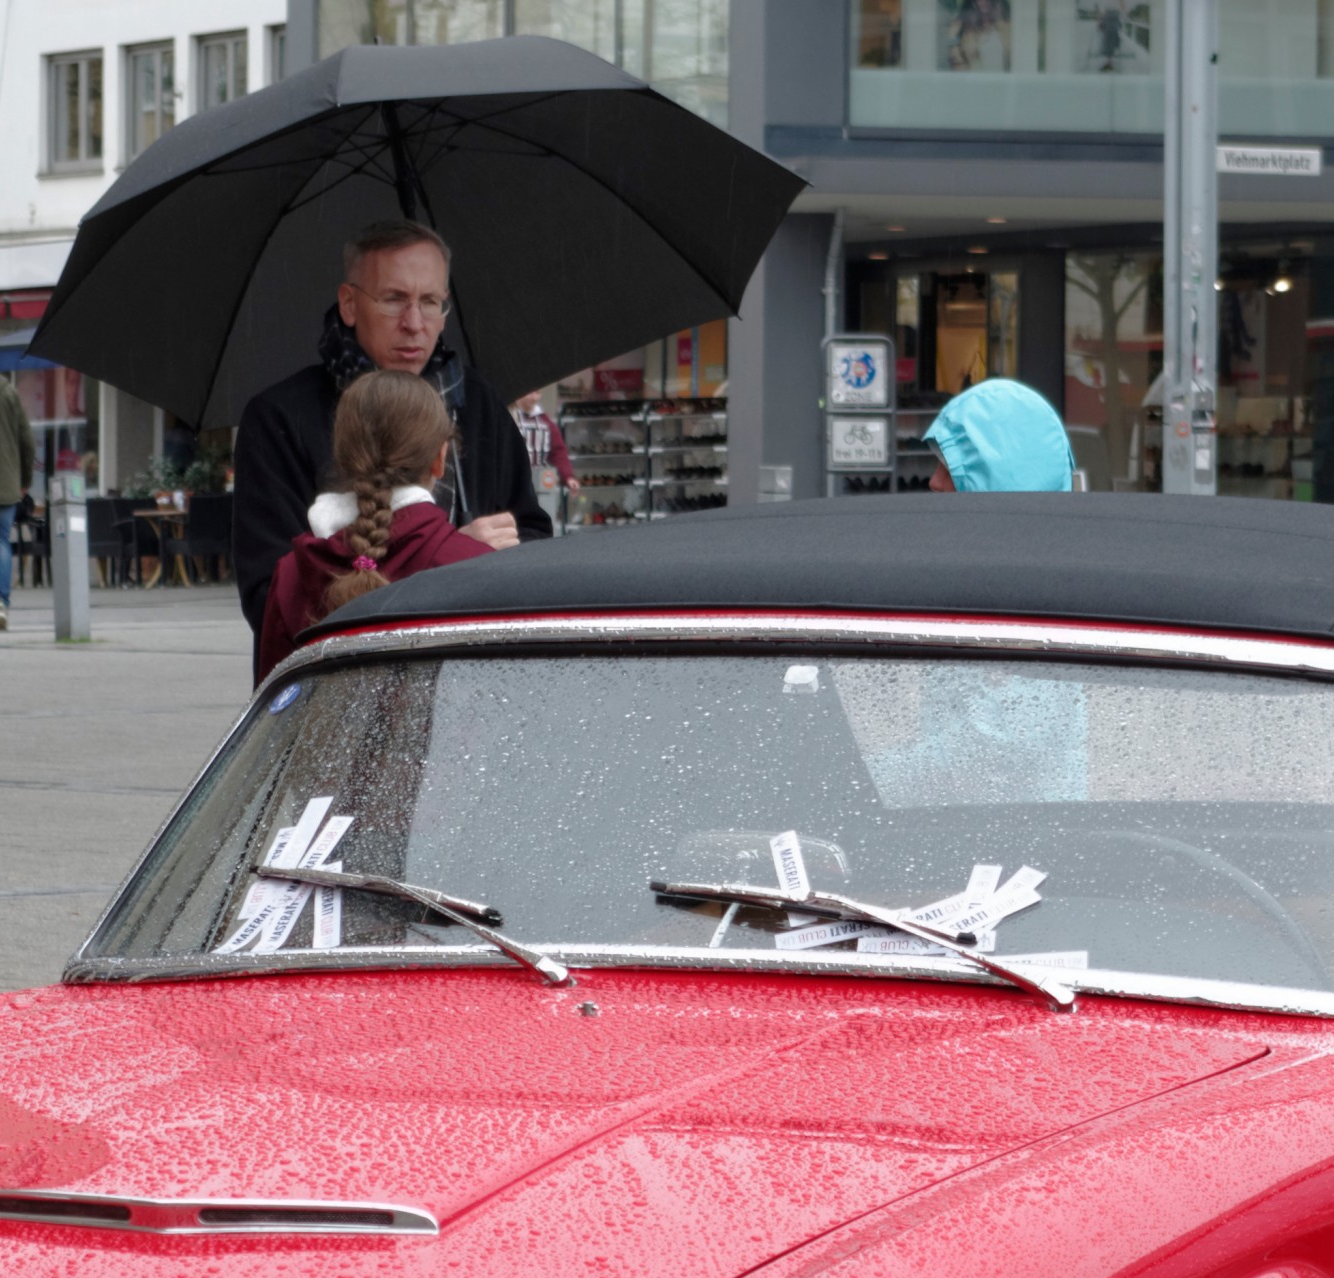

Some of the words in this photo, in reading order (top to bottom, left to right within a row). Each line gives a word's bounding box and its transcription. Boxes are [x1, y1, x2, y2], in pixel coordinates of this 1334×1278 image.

[1224, 151, 1311, 173] Viehmarktplatz
[779, 847, 802, 891] MASERATI
[798, 928, 828, 941] CLUB
[880, 939, 910, 952] CLUB
